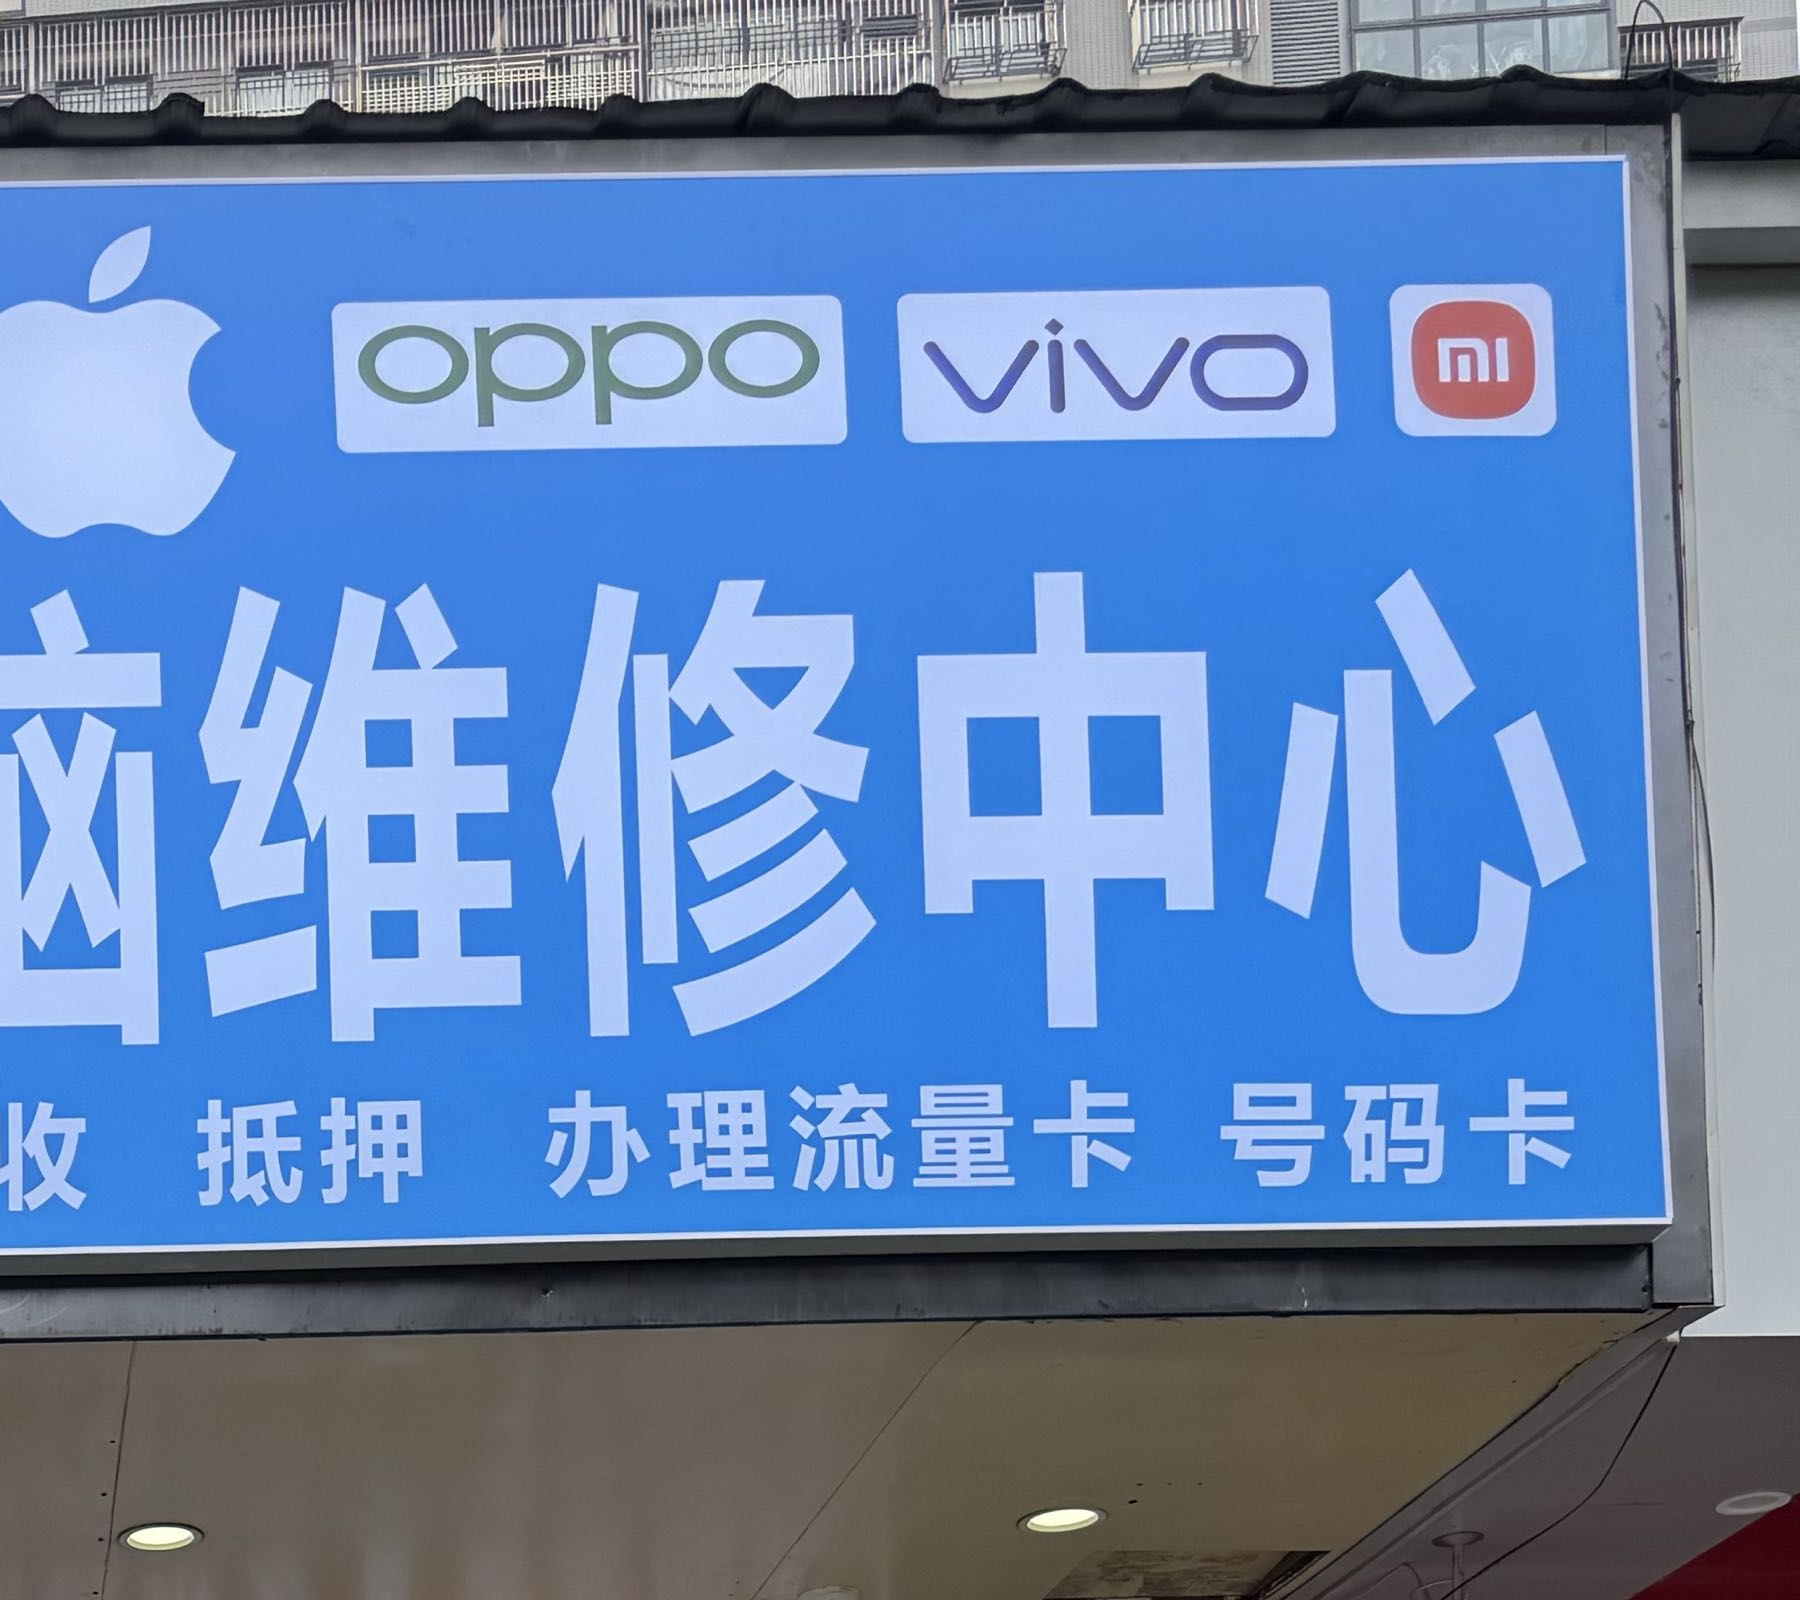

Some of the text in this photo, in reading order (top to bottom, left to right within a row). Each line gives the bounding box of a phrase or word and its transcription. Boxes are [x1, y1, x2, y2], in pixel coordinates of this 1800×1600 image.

[196, 1096, 425, 1208] 抵押
[544, 1082, 1137, 1199] 办理流量卡
[1219, 1075, 1575, 1190] 号码卡
